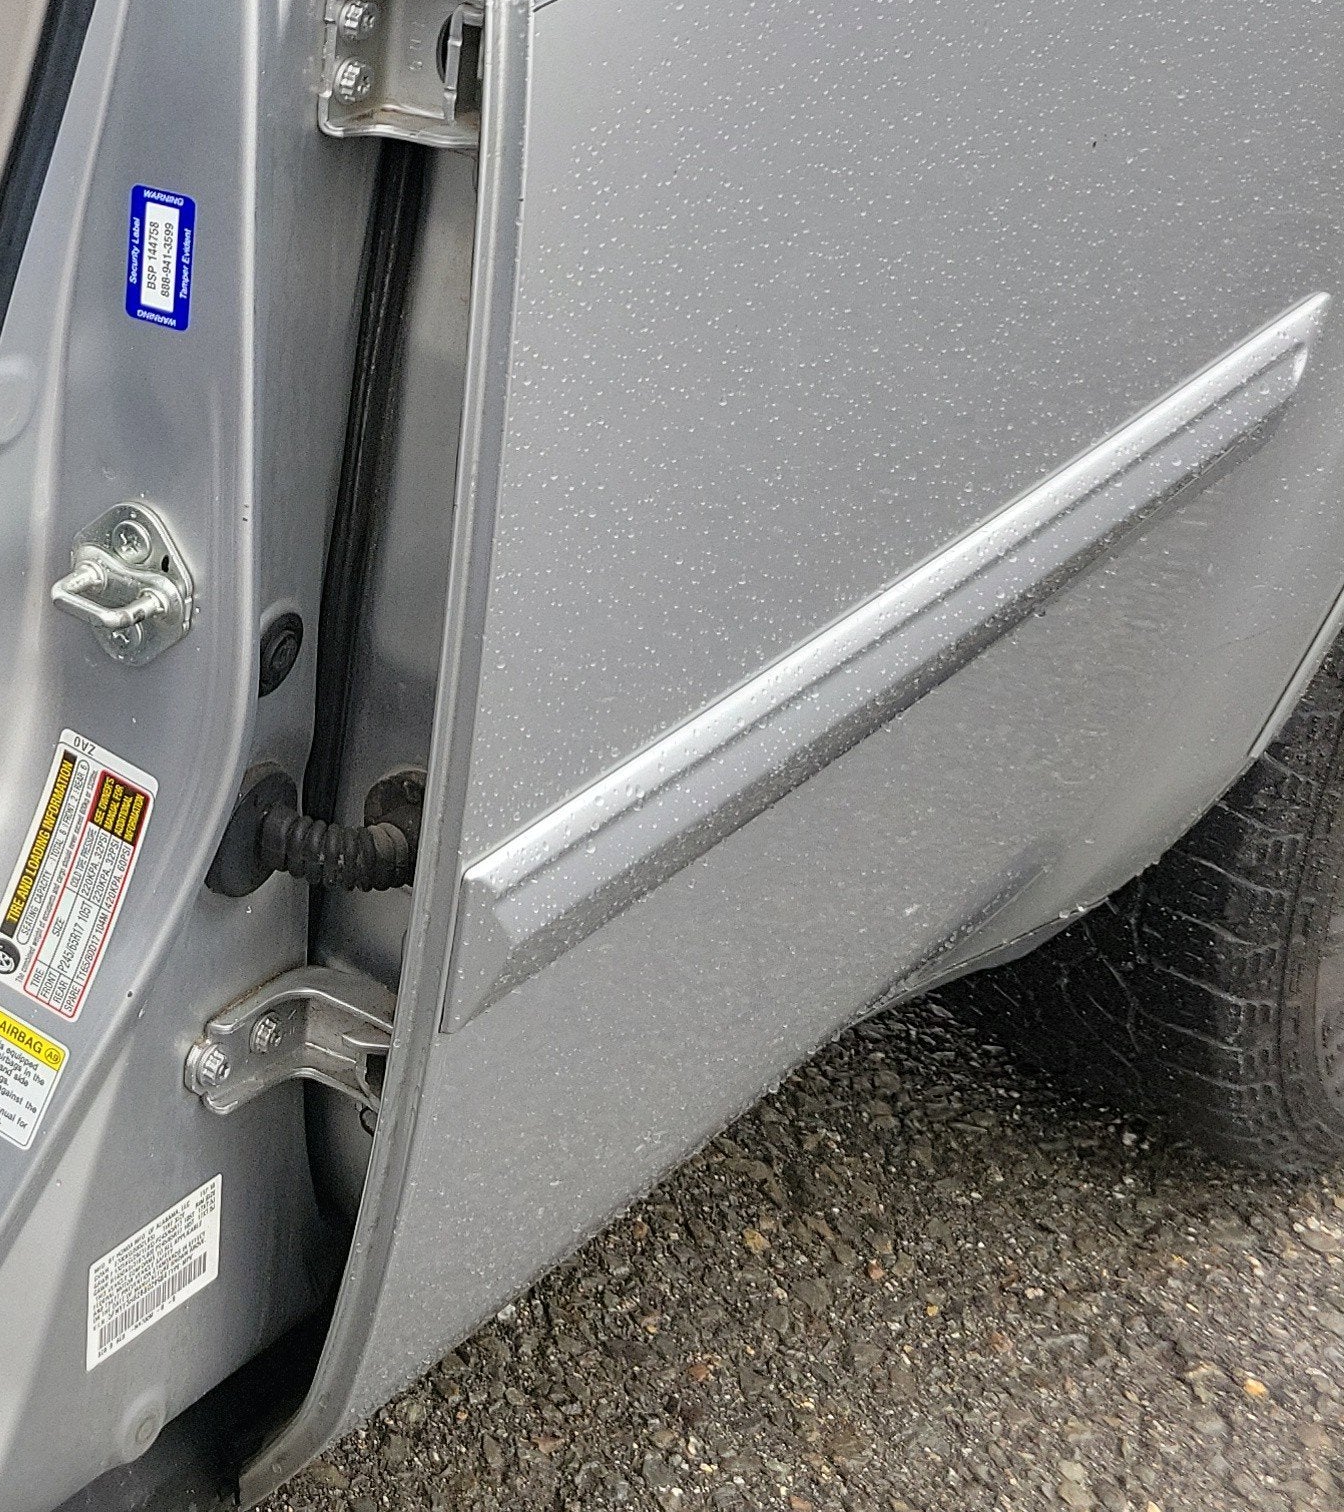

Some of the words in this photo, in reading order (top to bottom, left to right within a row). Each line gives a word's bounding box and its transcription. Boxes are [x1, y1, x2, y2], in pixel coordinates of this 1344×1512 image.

[143, 189, 184, 207] WARNING
[131, 216, 140, 244] Label
[147, 220, 159, 261] 144758
[160, 221, 173, 298] 888-941-3599
[181, 227, 191, 264] Evident
[129, 244, 139, 284] Security
[146, 264, 157, 290] BSP
[179, 264, 190, 300] Tamper
[136, 309, 177, 327] WARNING
[111, 783, 124, 801] FOR
[93, 808, 105, 825] SEE
[103, 799, 120, 830] MANUAL
[112, 792, 134, 836] ADDITIONAL
[121, 792, 147, 842] INFORMATION
[5, 895, 24, 925] TIRE
[15, 873, 33, 900] AND
[24, 827, 50, 877] LOADING
[40, 758, 75, 831] INFORMATION
[20, 903, 38, 936] SEATING
[33, 868, 52, 904] CAPACITY
[72, 771, 85, 791] REAR
[93, 831, 109, 859] 32PSI
[104, 838, 120, 866] 32PSI
[116, 844, 131, 872] 60PSI
[51, 915, 65, 938] SIZE
[56, 920, 85, 975] P245/65R17
[76, 899, 93, 924] 105T
[29, 966, 44, 989] TIRE
[39, 969, 57, 999] FRONT
[52, 978, 68, 1005] REAR
[63, 983, 80, 1013] SPARE
[4, 1045, 39, 1072] equipped
[12, 1071, 30, 1087] side
[23, 1067, 32, 1077] in
[32, 1072, 46, 1086] the
[24, 1100, 38, 1113] the
[16, 1116, 28, 1129] for
